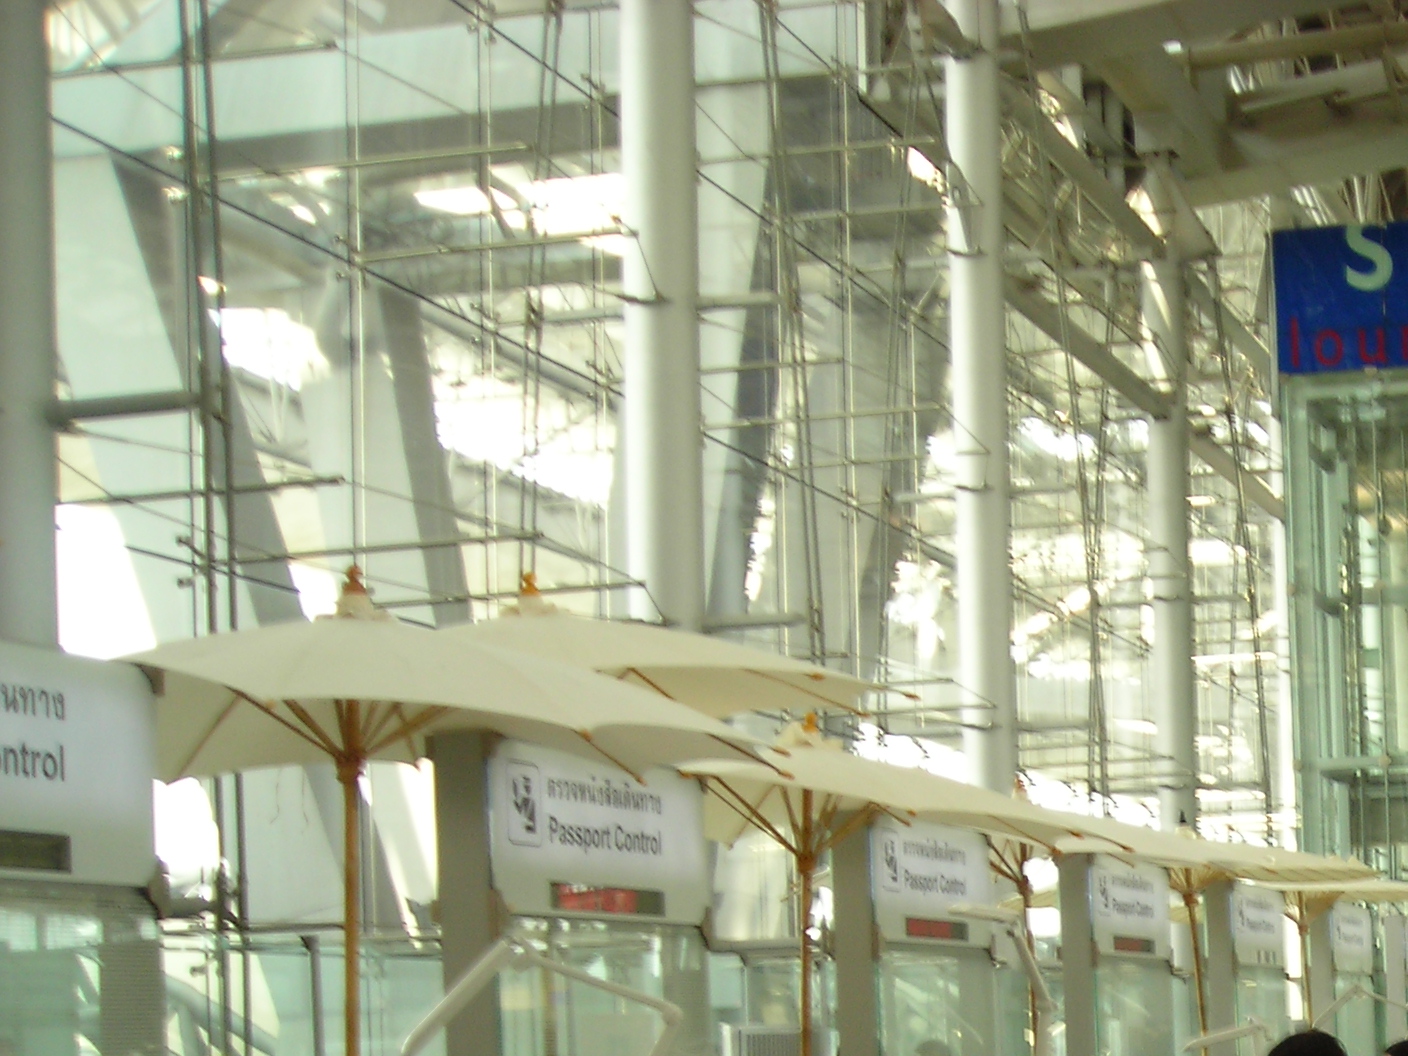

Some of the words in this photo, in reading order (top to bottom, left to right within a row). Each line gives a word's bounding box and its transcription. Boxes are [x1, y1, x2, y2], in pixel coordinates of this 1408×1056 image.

[0, 743, 65, 782] ntrol
[548, 815, 611, 854] Passport
[614, 824, 662, 855] Control
